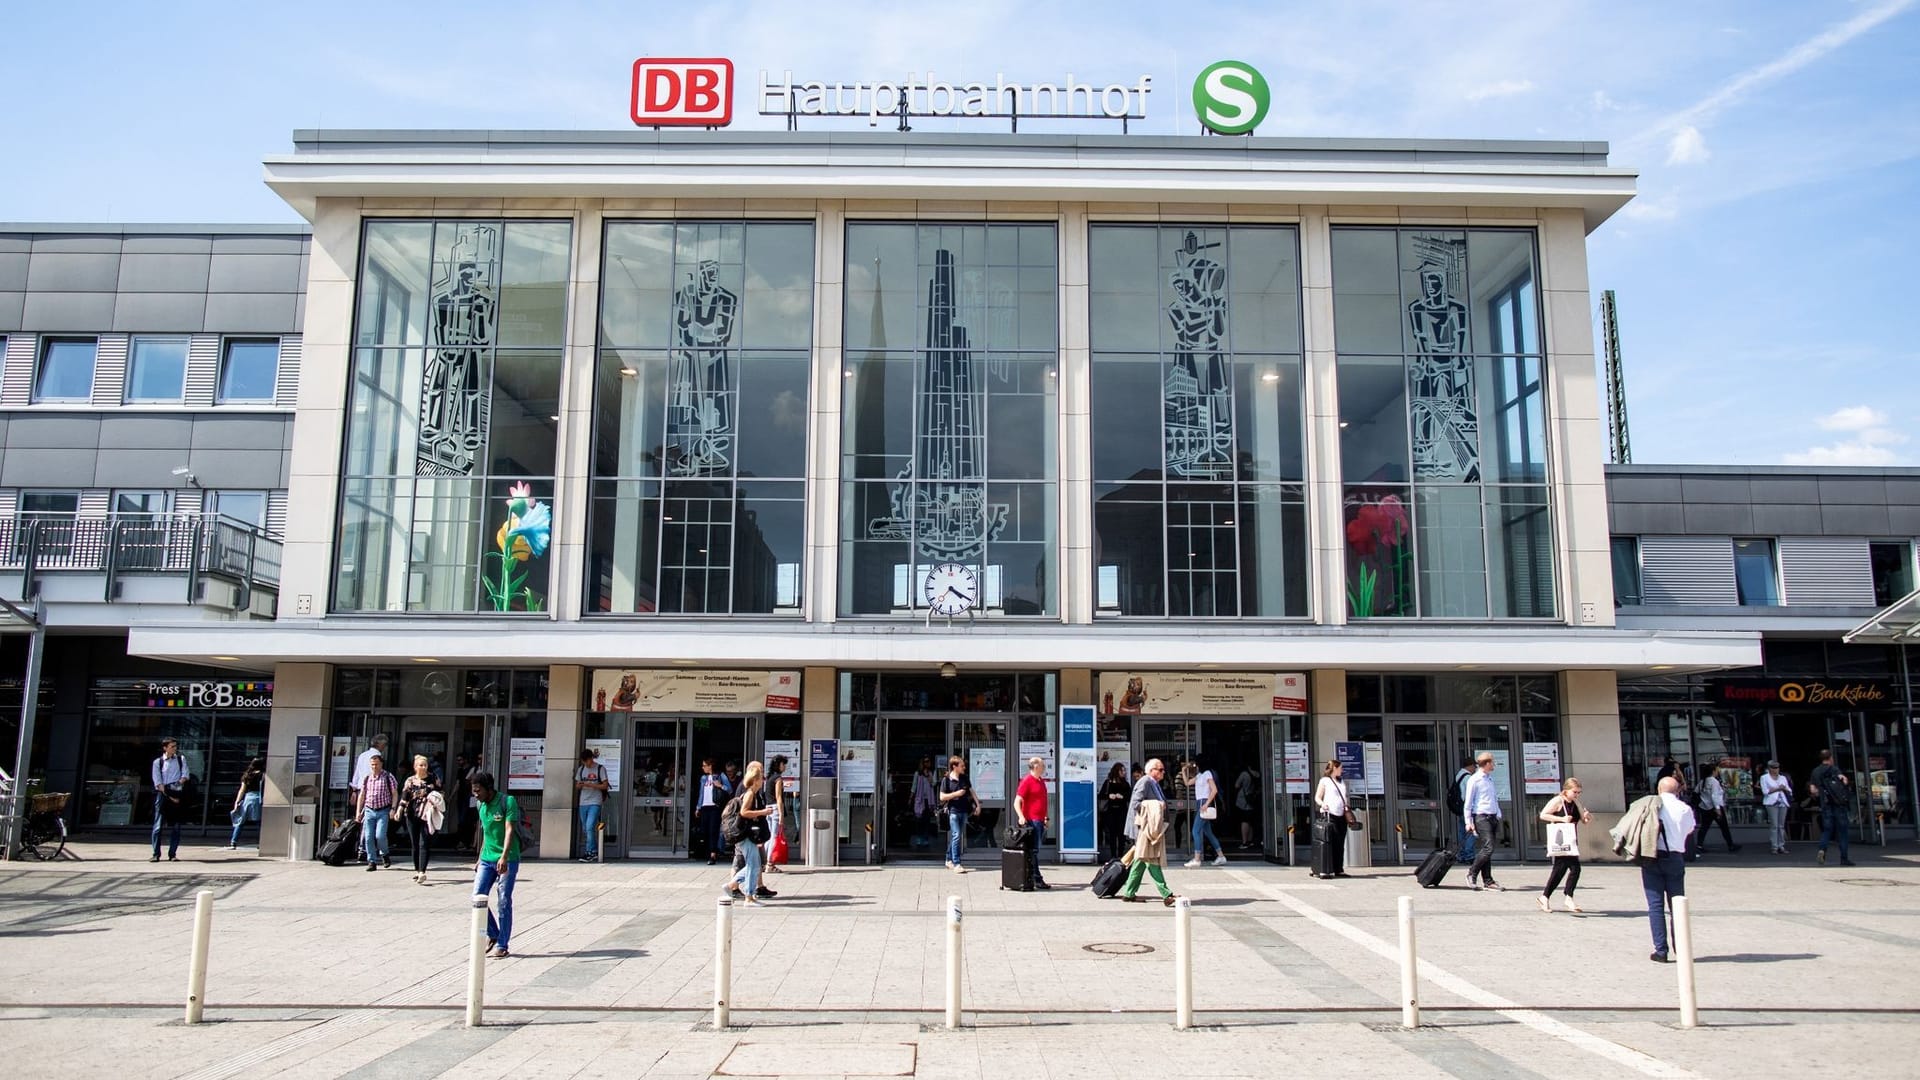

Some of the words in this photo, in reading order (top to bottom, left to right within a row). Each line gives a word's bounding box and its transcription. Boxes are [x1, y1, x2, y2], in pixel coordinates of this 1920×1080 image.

[643, 69, 720, 113] DB
[758, 69, 1152, 126] Hauptbahnhof
[1202, 66, 1261, 126] S
[149, 683, 180, 695] Press
[188, 681, 233, 707] P&B
[235, 695, 272, 707] Books
[1805, 682, 1885, 706] Backstube
